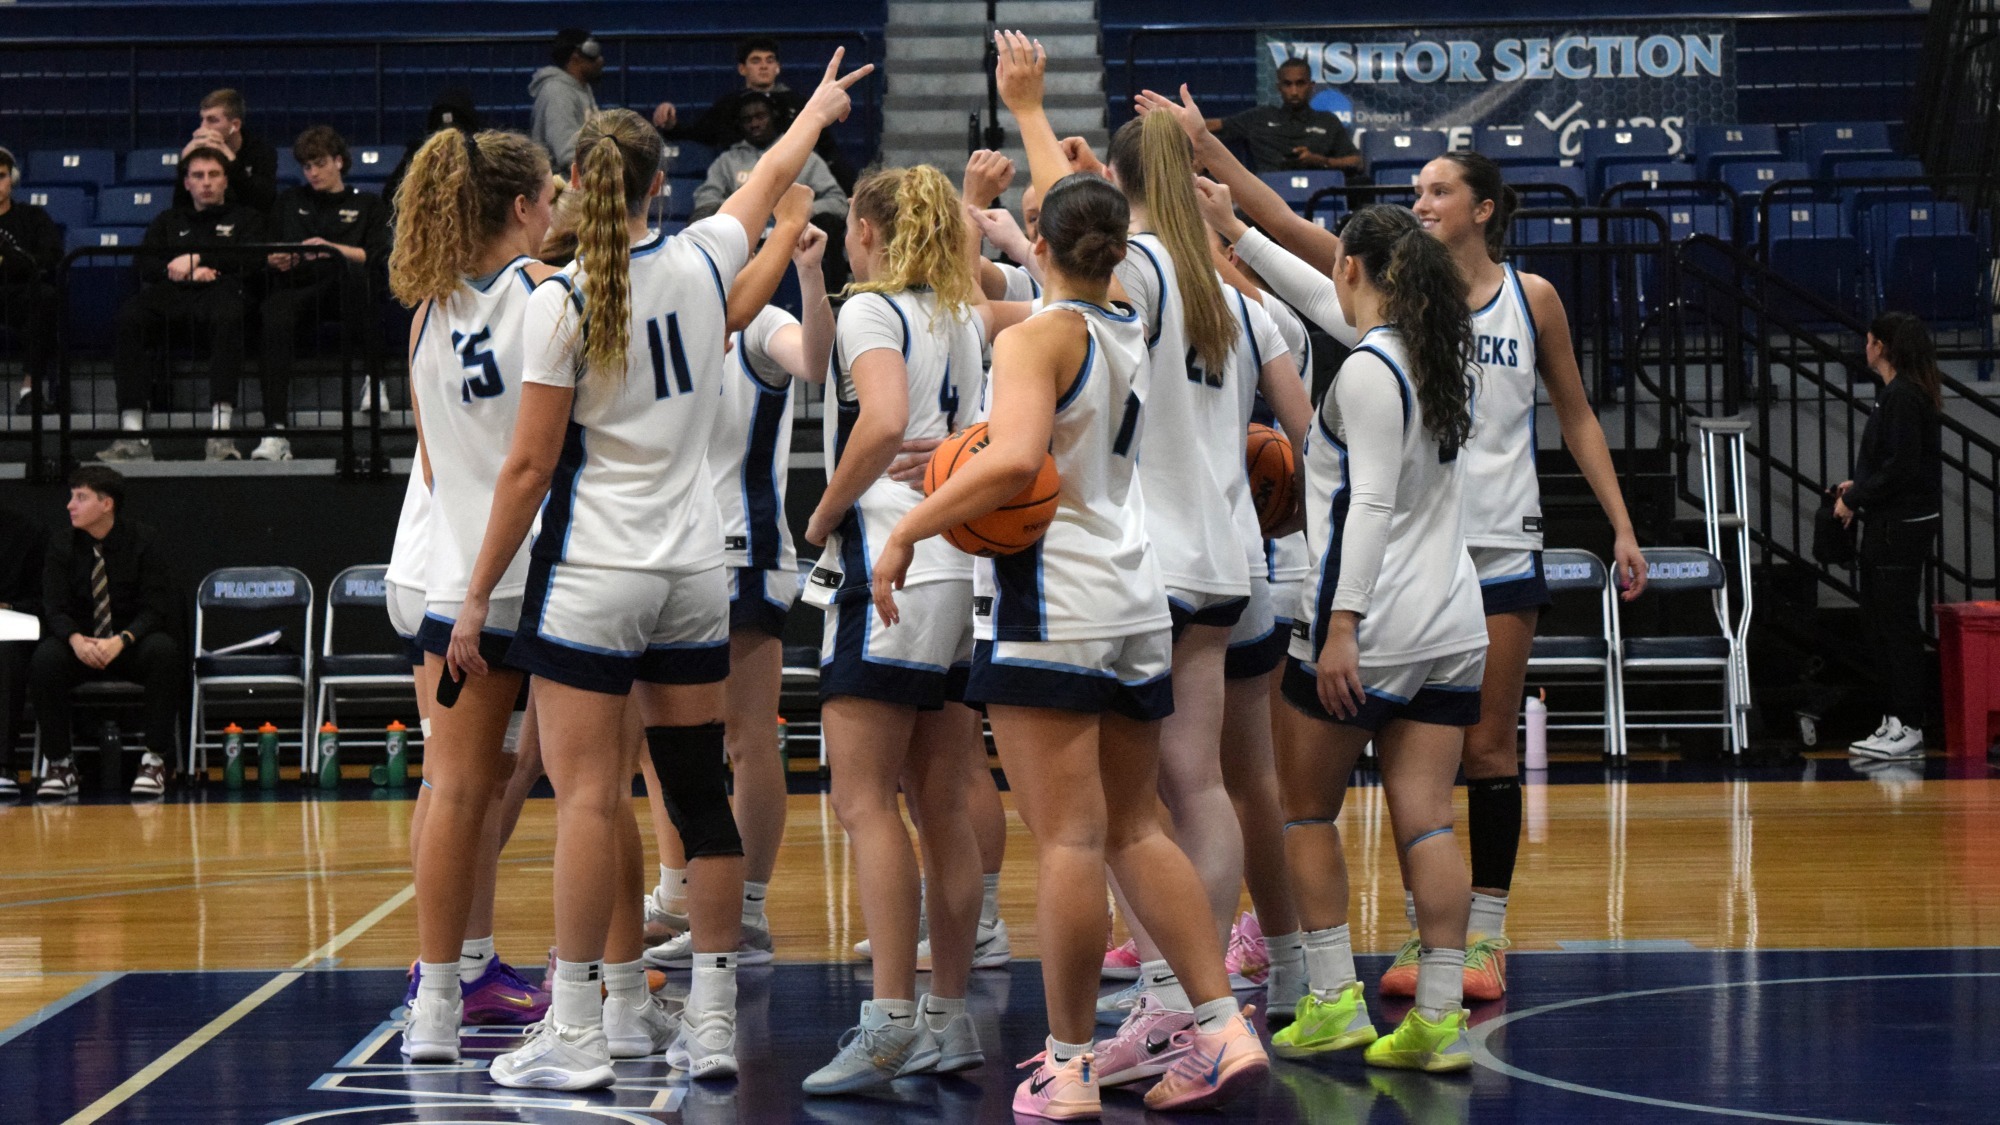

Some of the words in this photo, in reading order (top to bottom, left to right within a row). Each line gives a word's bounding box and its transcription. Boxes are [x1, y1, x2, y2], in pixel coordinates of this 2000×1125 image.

[1492, 34, 1724, 82] SECTION
[1355, 111, 1401, 124] Division
[451, 323, 505, 403] 15
[646, 311, 694, 401] 11
[938, 353, 960, 433] 4
[214, 580, 295, 598] PEACOCKS
